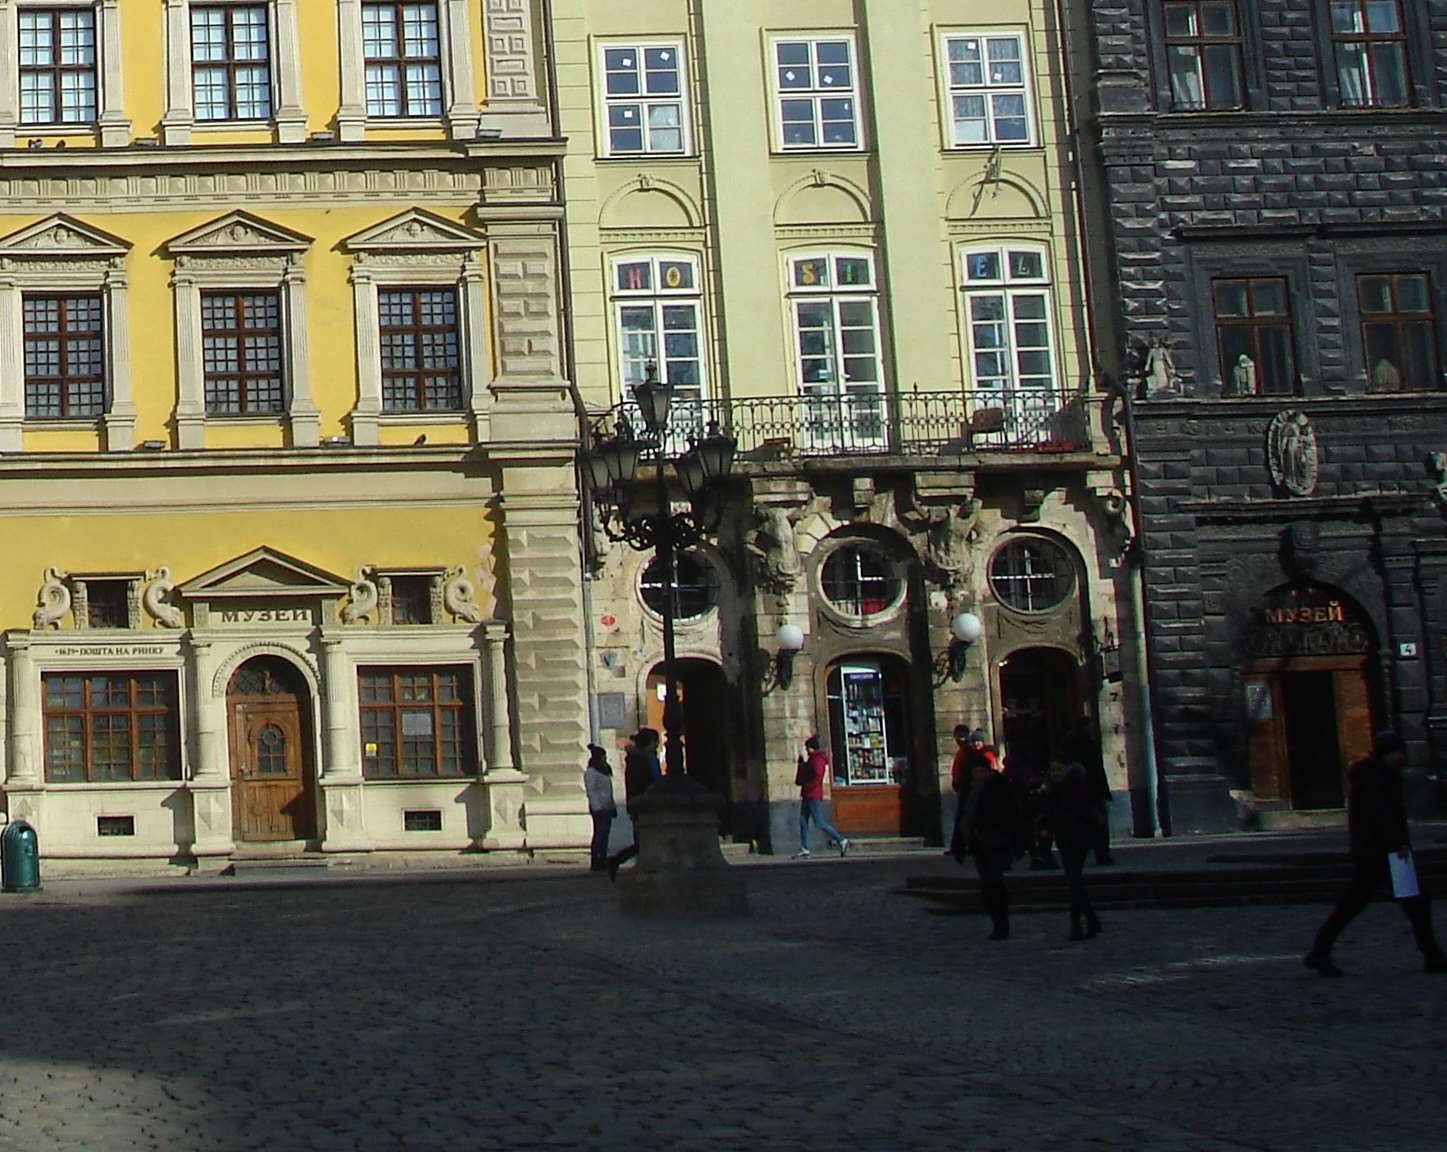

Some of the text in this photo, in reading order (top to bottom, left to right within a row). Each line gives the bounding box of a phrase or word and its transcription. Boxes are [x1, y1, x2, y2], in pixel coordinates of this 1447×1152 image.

[1265, 600, 1344, 623] МУЗЕЙ
[79, 646, 114, 656] ПОШТА
[115, 646, 130, 656] НА
[131, 646, 165, 656] РИНКУ
